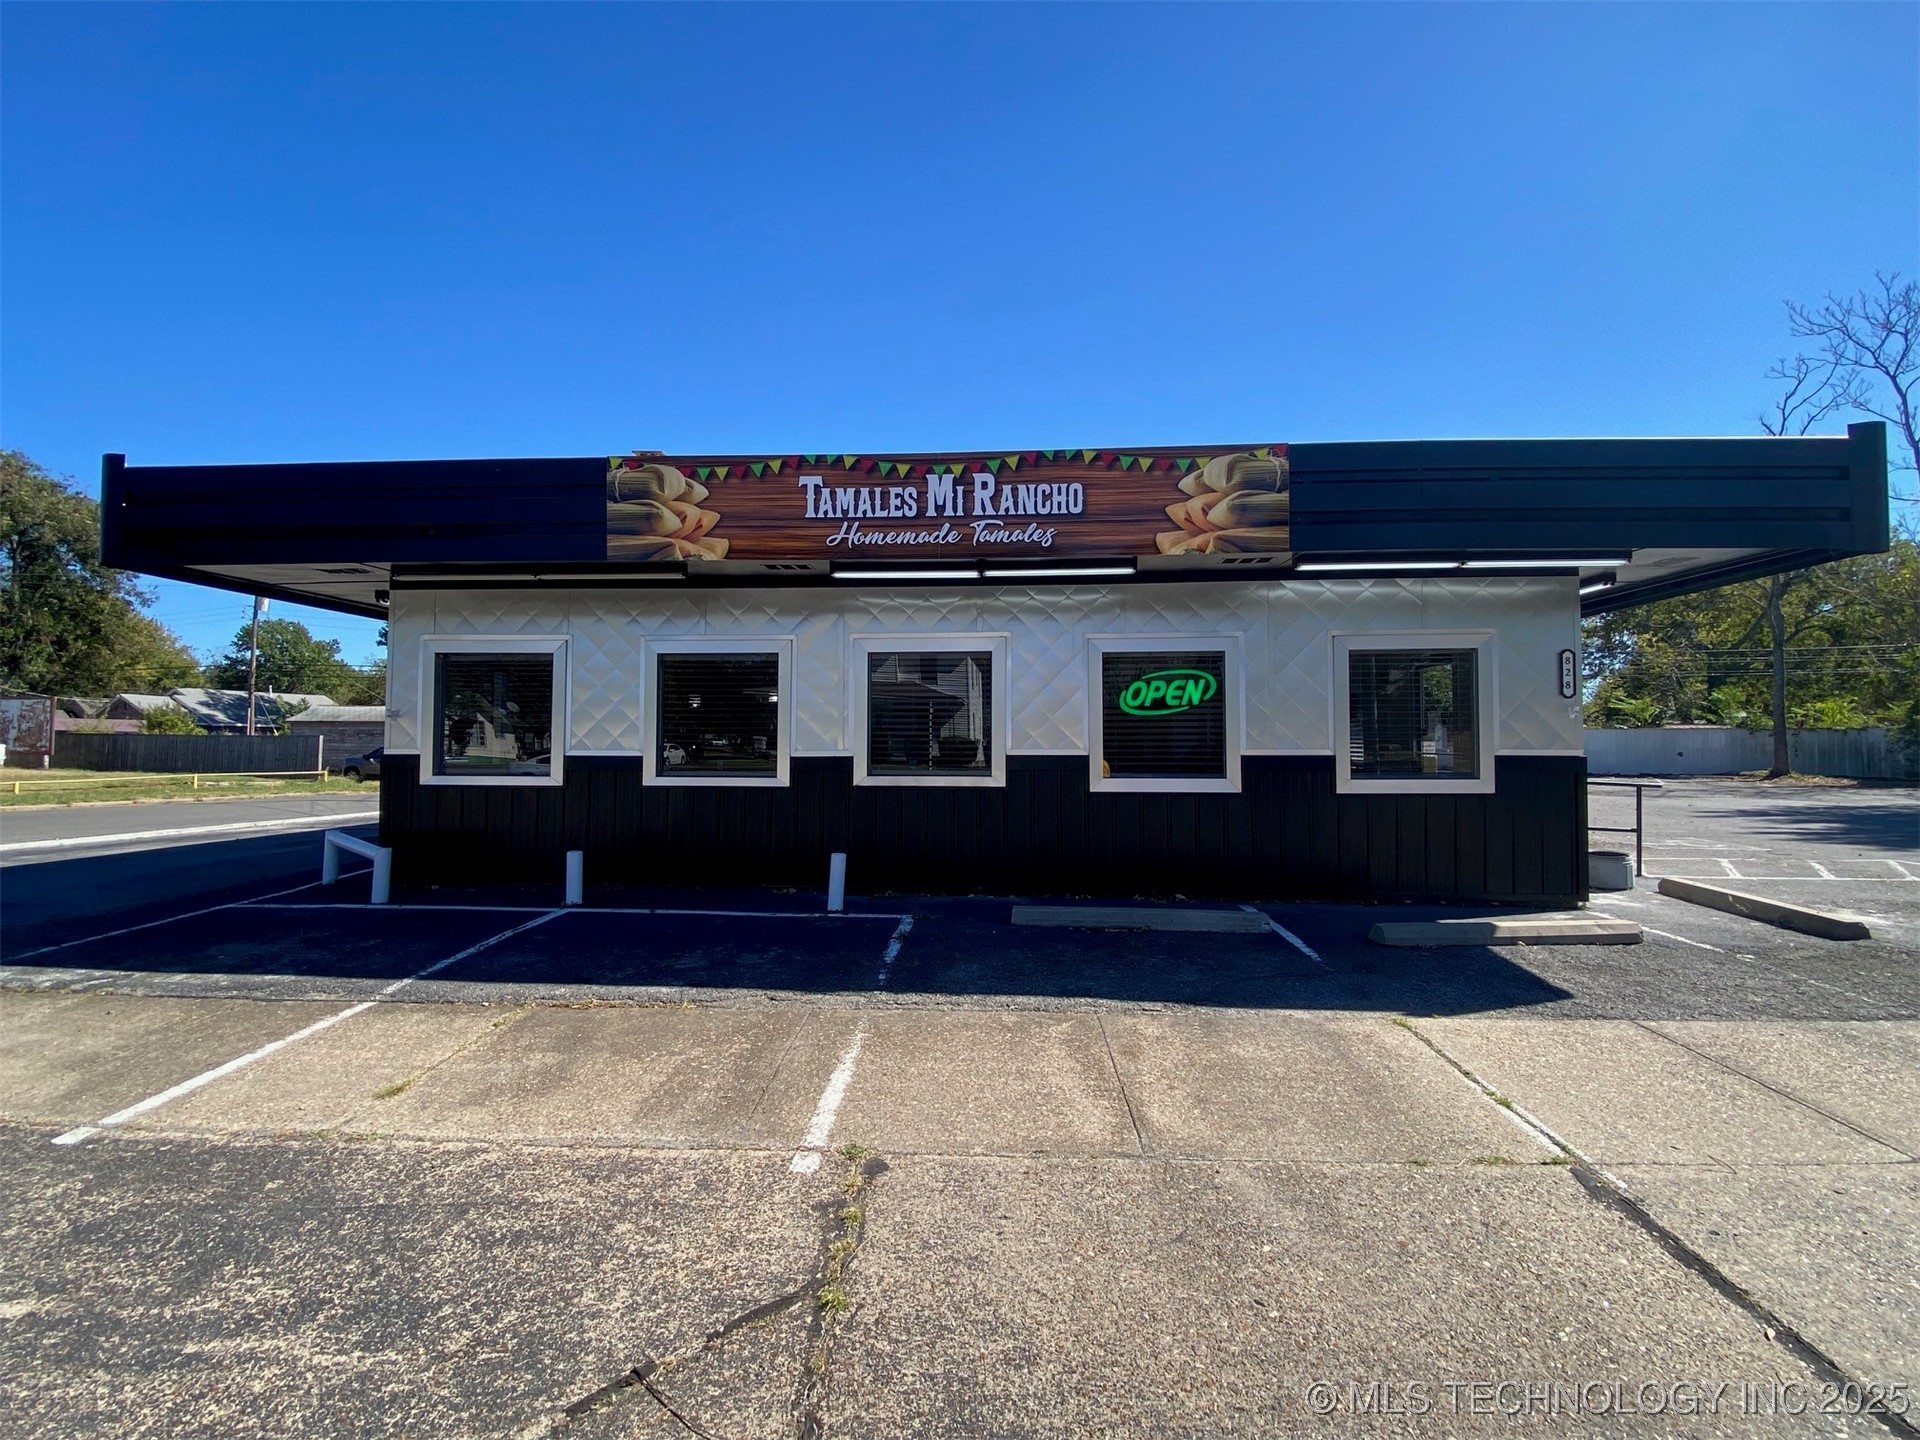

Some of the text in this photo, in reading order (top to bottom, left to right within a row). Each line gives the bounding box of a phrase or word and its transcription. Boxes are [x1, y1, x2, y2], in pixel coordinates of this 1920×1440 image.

[798, 475, 918, 518] TAMALES
[971, 472, 1084, 516] RANCHO
[826, 519, 1058, 548] Homemade Tamales
[1564, 656, 1572, 690] 828
[1125, 679, 1206, 707] OPEN
